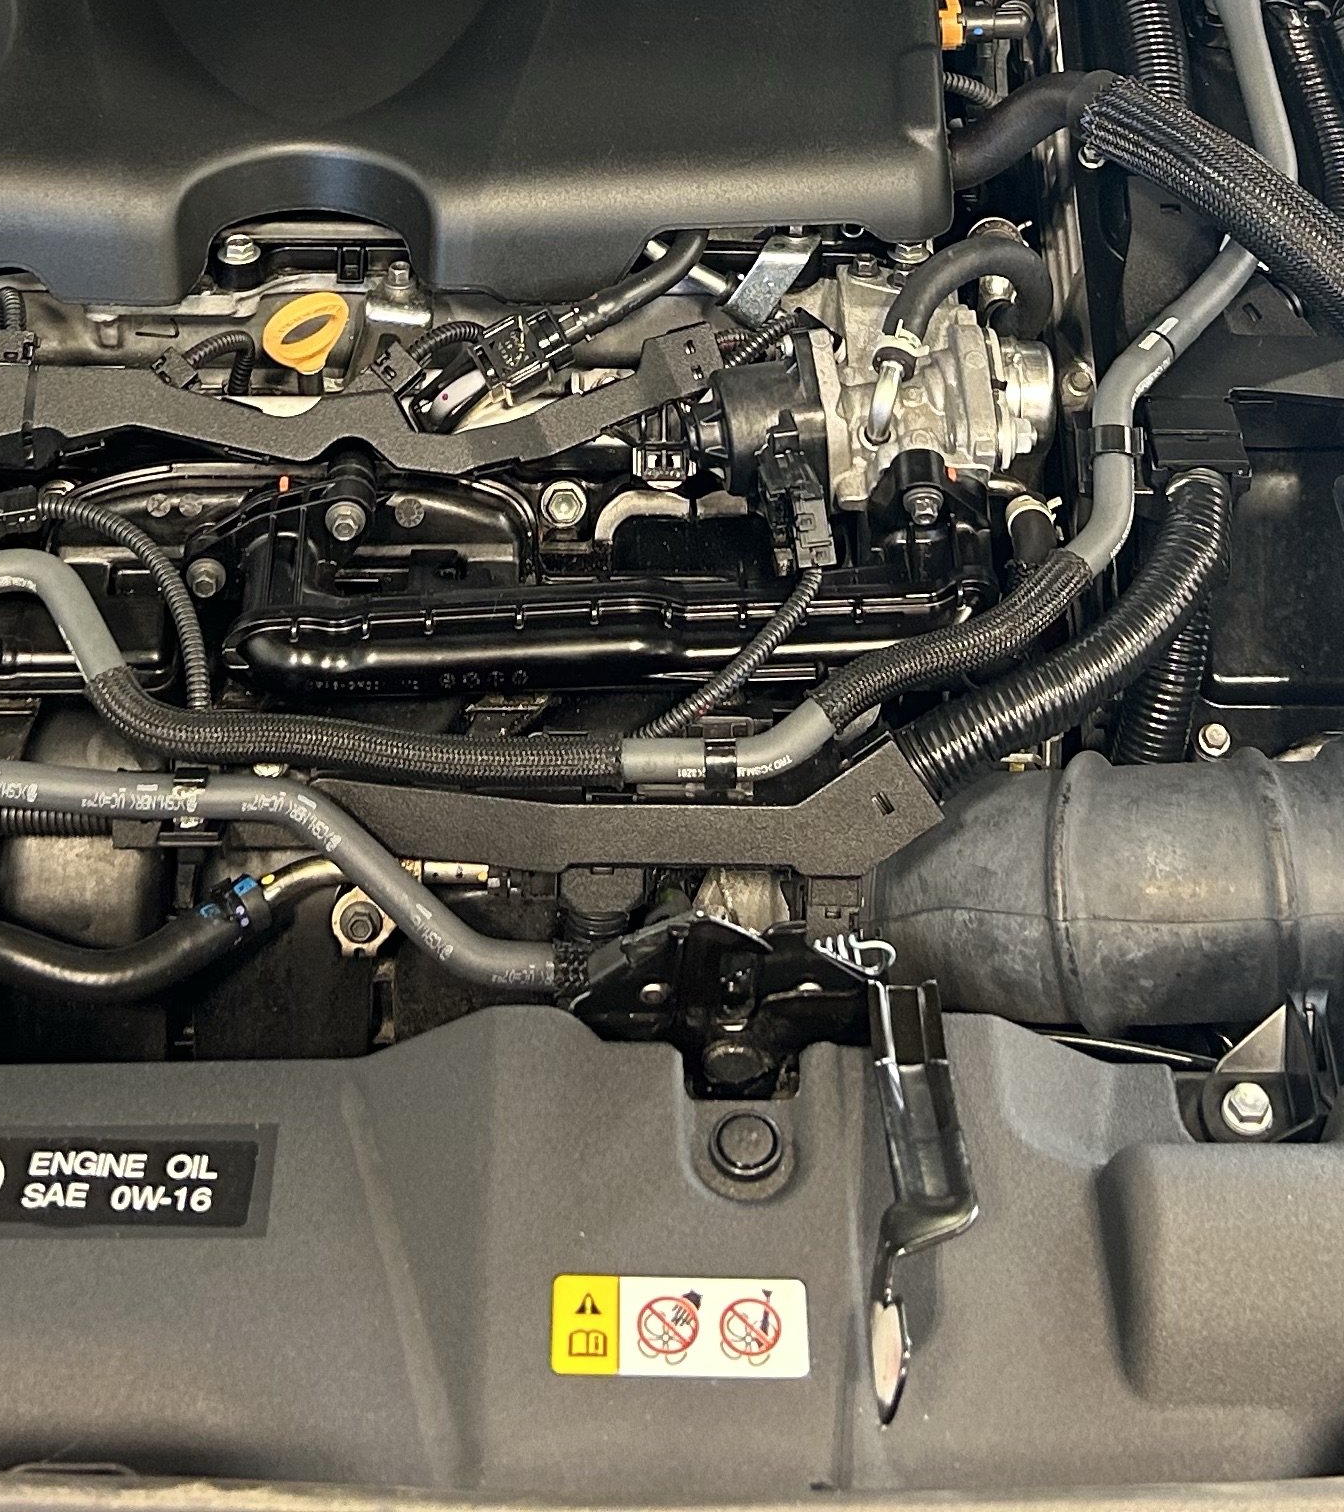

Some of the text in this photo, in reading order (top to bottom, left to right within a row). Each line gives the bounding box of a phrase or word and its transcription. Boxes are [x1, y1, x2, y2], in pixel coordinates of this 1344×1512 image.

[28, 1151, 218, 1181] ENGINE OIL
[21, 1182, 213, 1213] SAE 0W-16
